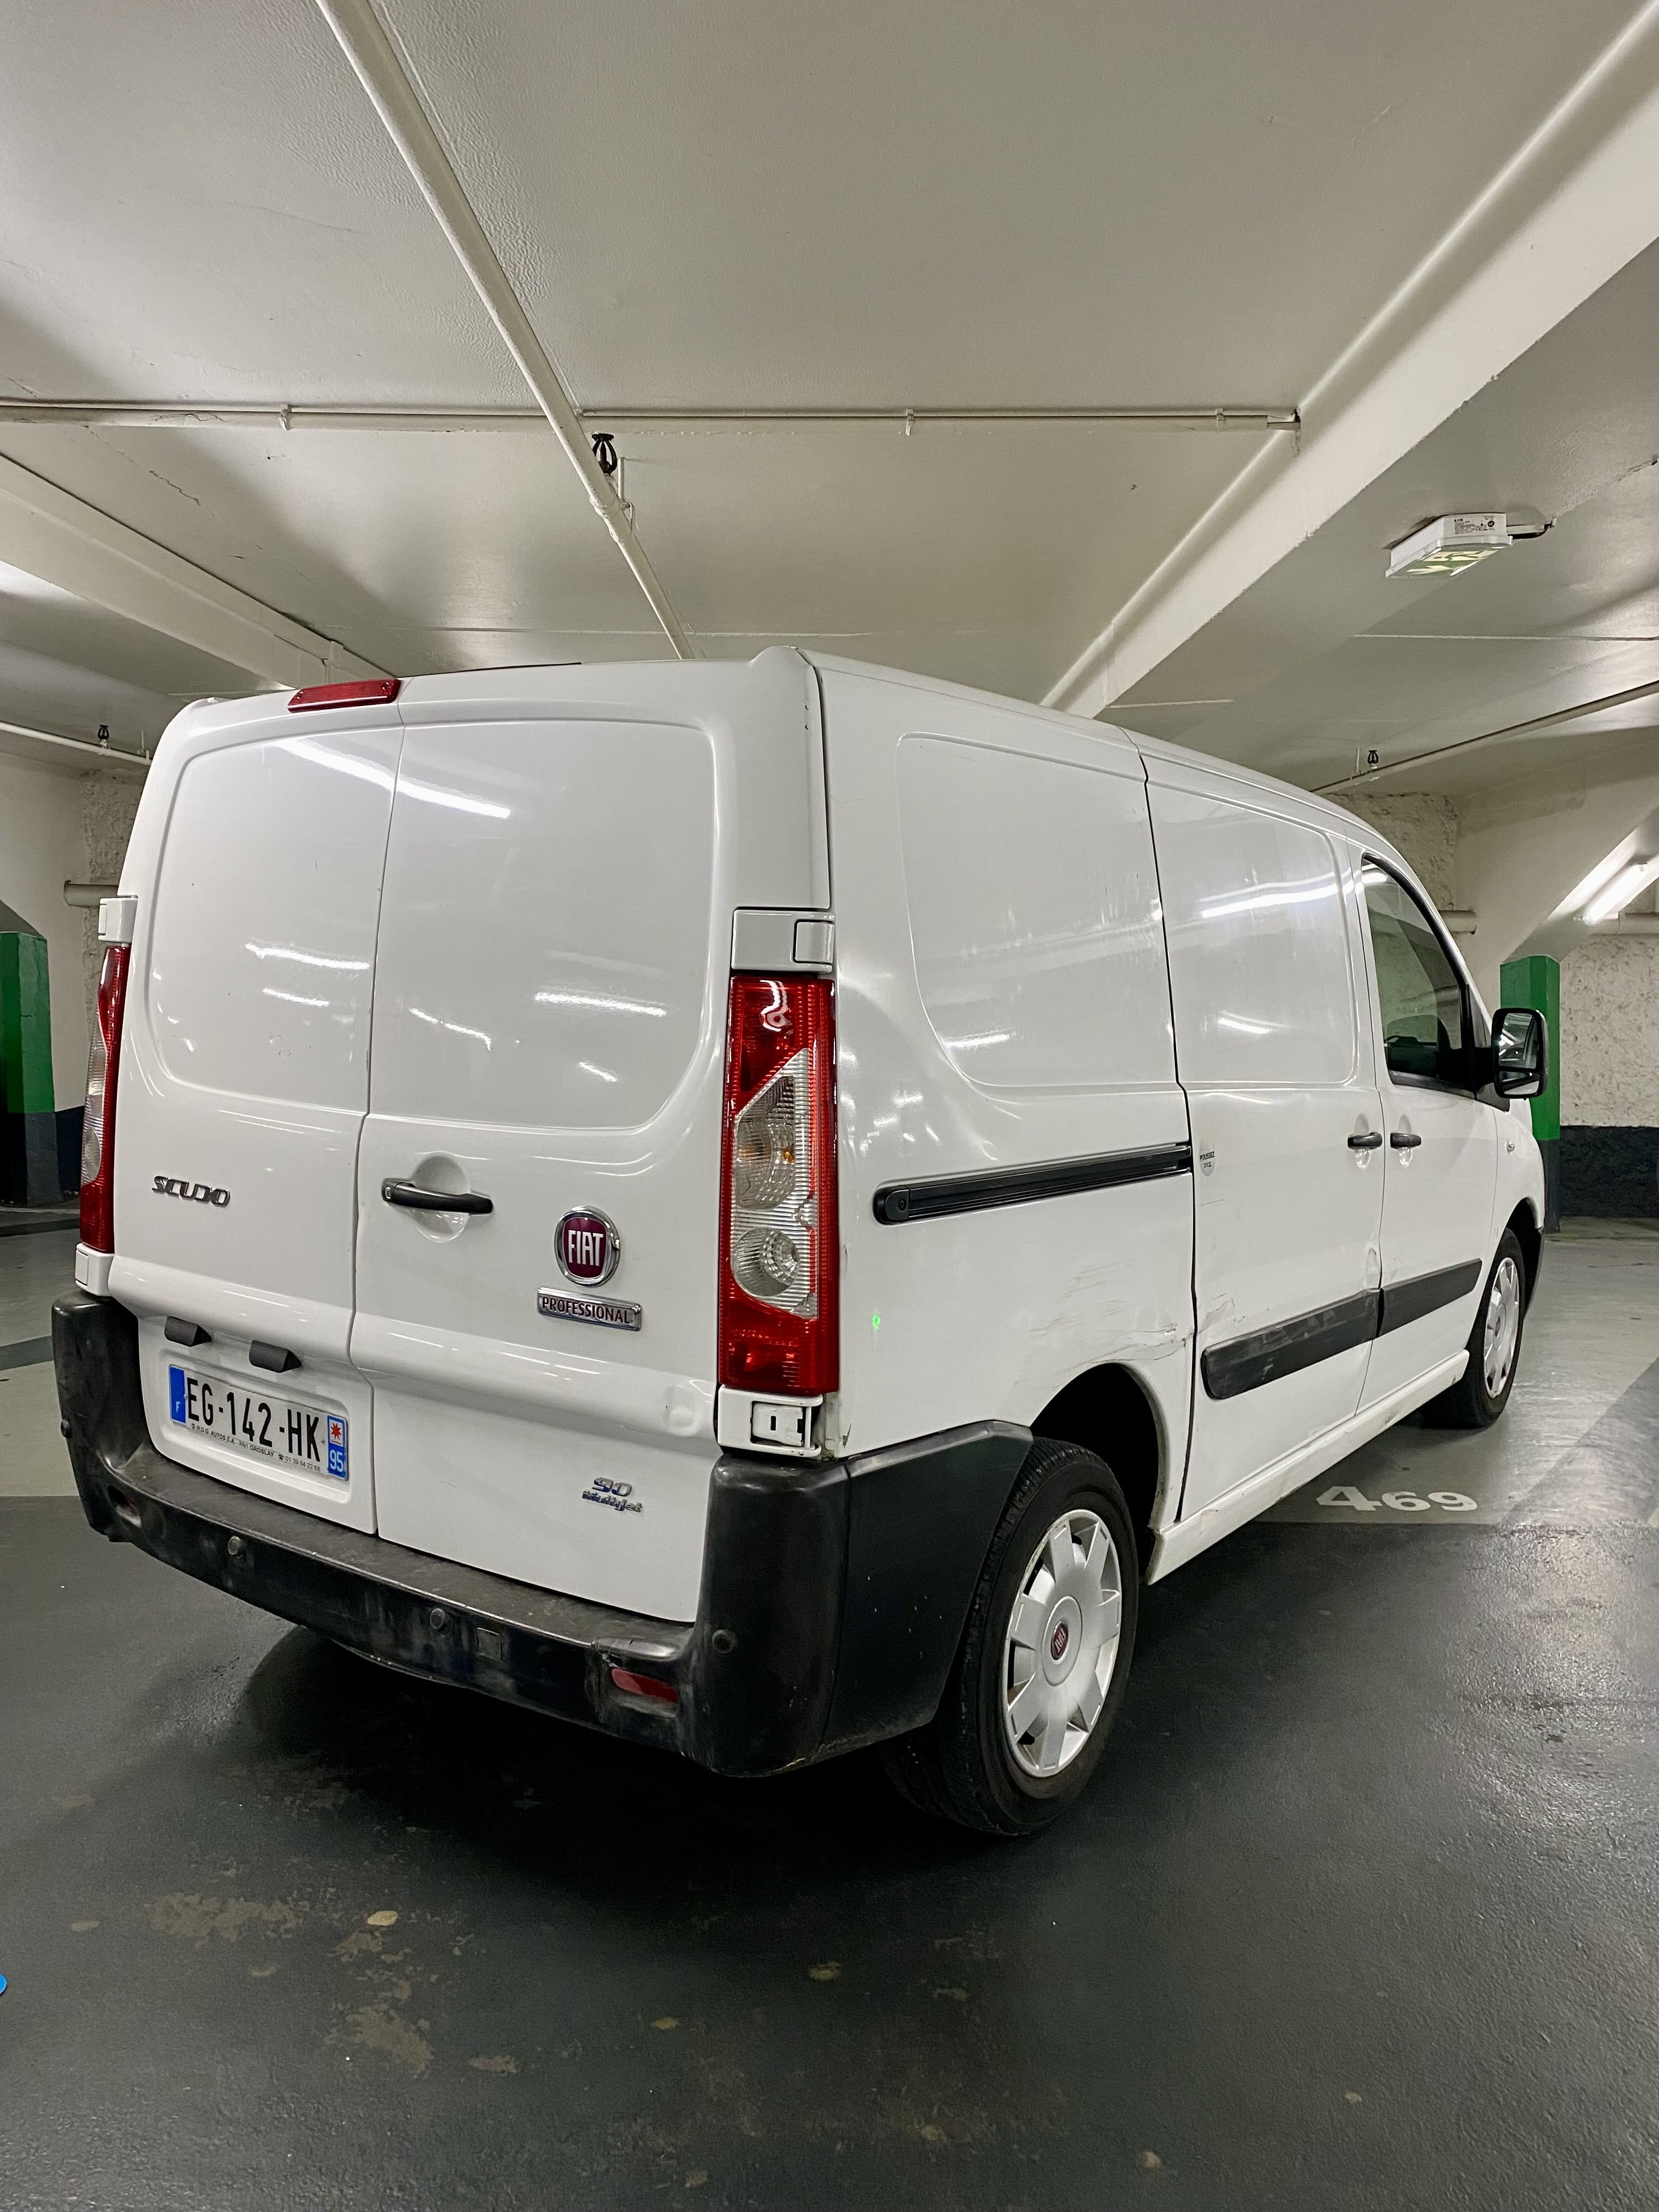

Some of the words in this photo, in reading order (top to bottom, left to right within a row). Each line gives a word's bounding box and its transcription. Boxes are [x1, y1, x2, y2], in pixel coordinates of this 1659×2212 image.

[152, 1175, 230, 1206] SCUDO
[568, 1229, 603, 1267] FIAT
[542, 1296, 630, 1324] PROFESSIONAL
[176, 1401, 180, 1413] F
[187, 1377, 320, 1462] EG-142-HK
[210, 1431, 226, 1441] AUTOS
[250, 1444, 275, 1457] GROSLAY
[330, 1449, 344, 1472] 95
[591, 1476, 632, 1497] 90
[1316, 1486, 1478, 1511] 469
[1054, 1628, 1066, 1654] FIAT
